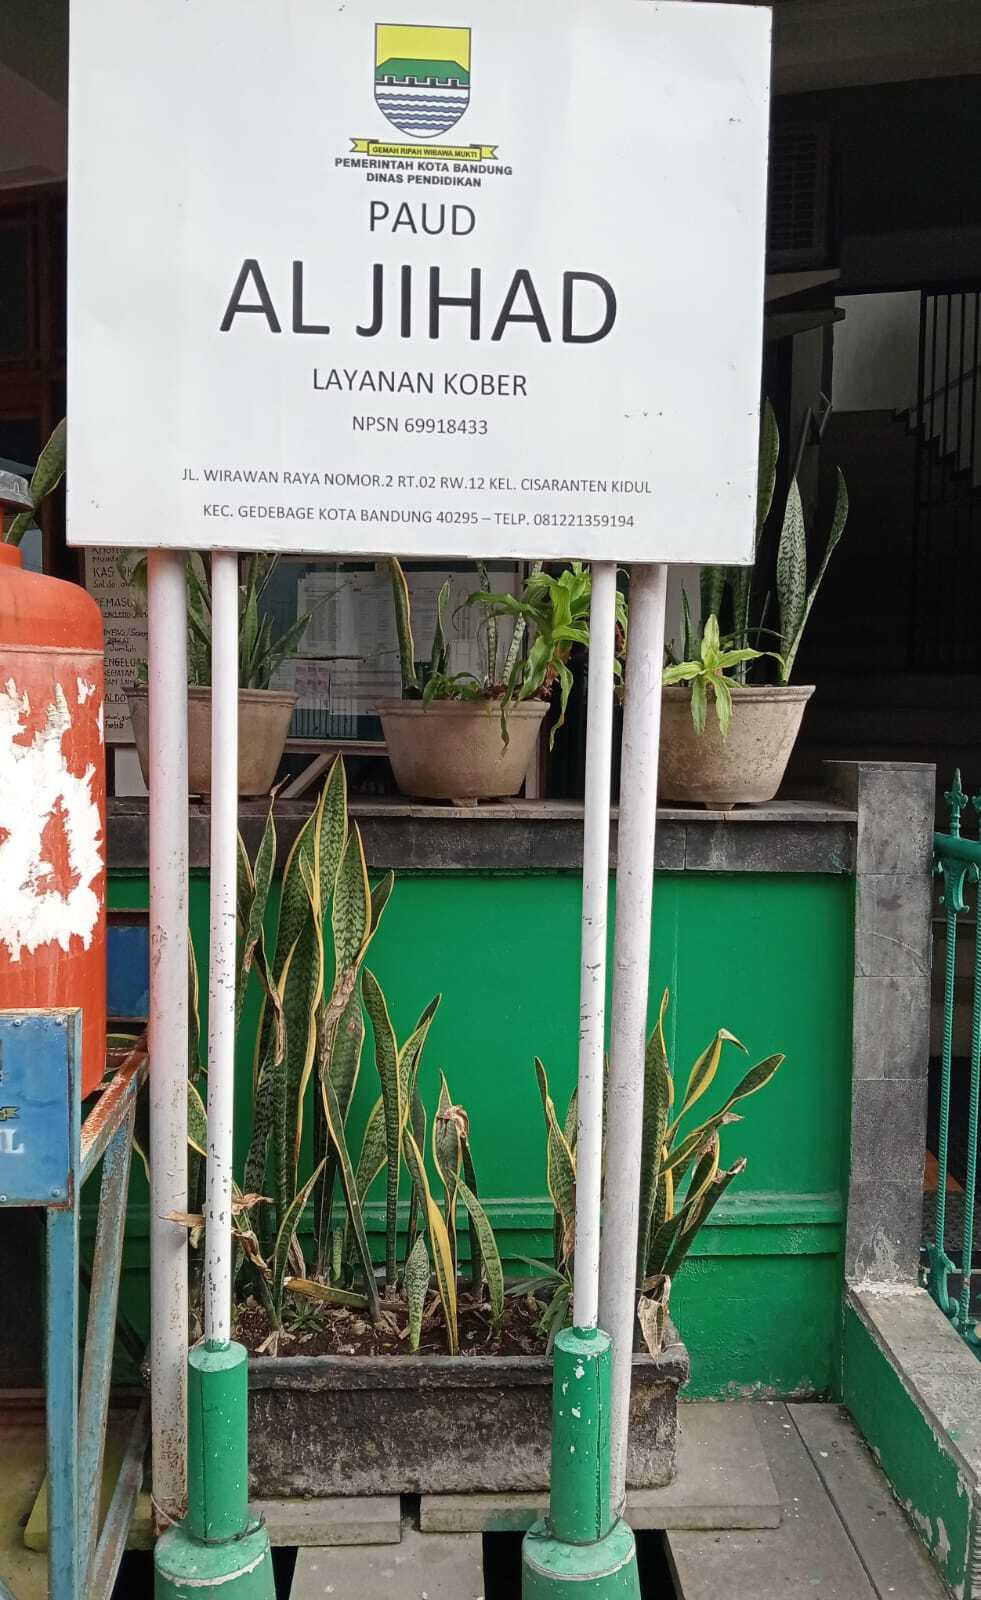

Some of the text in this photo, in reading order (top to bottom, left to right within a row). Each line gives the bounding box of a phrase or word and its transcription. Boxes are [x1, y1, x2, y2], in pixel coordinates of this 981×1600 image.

[372, 146, 478, 159] GEMAH RIPAH WIBAWA MUKTI
[334, 157, 514, 176] PEMERINTAH KOTA BANDUNG
[366, 172, 482, 188] DINAS PENDIDIKAN
[369, 200, 476, 236] PAUD
[219, 258, 617, 344] AL JIHAD
[313, 368, 527, 397] LAYANAN KOBER
[352, 415, 488, 435] NPSN 69918433
[182, 468, 652, 494] JL. WIRAWAN RAYA NOMOR.2 RT.02 RW.12 KEL. CISARANTEN KIDUL
[203, 504, 233, 518] KEC.
[237, 505, 314, 520] GEDEBAGE
[319, 507, 357, 521] KOTA
[360, 509, 432, 523] BANDUNG
[436, 511, 479, 525] 40295
[494, 512, 530, 526] TELP.
[533, 513, 634, 528] 081221359194
